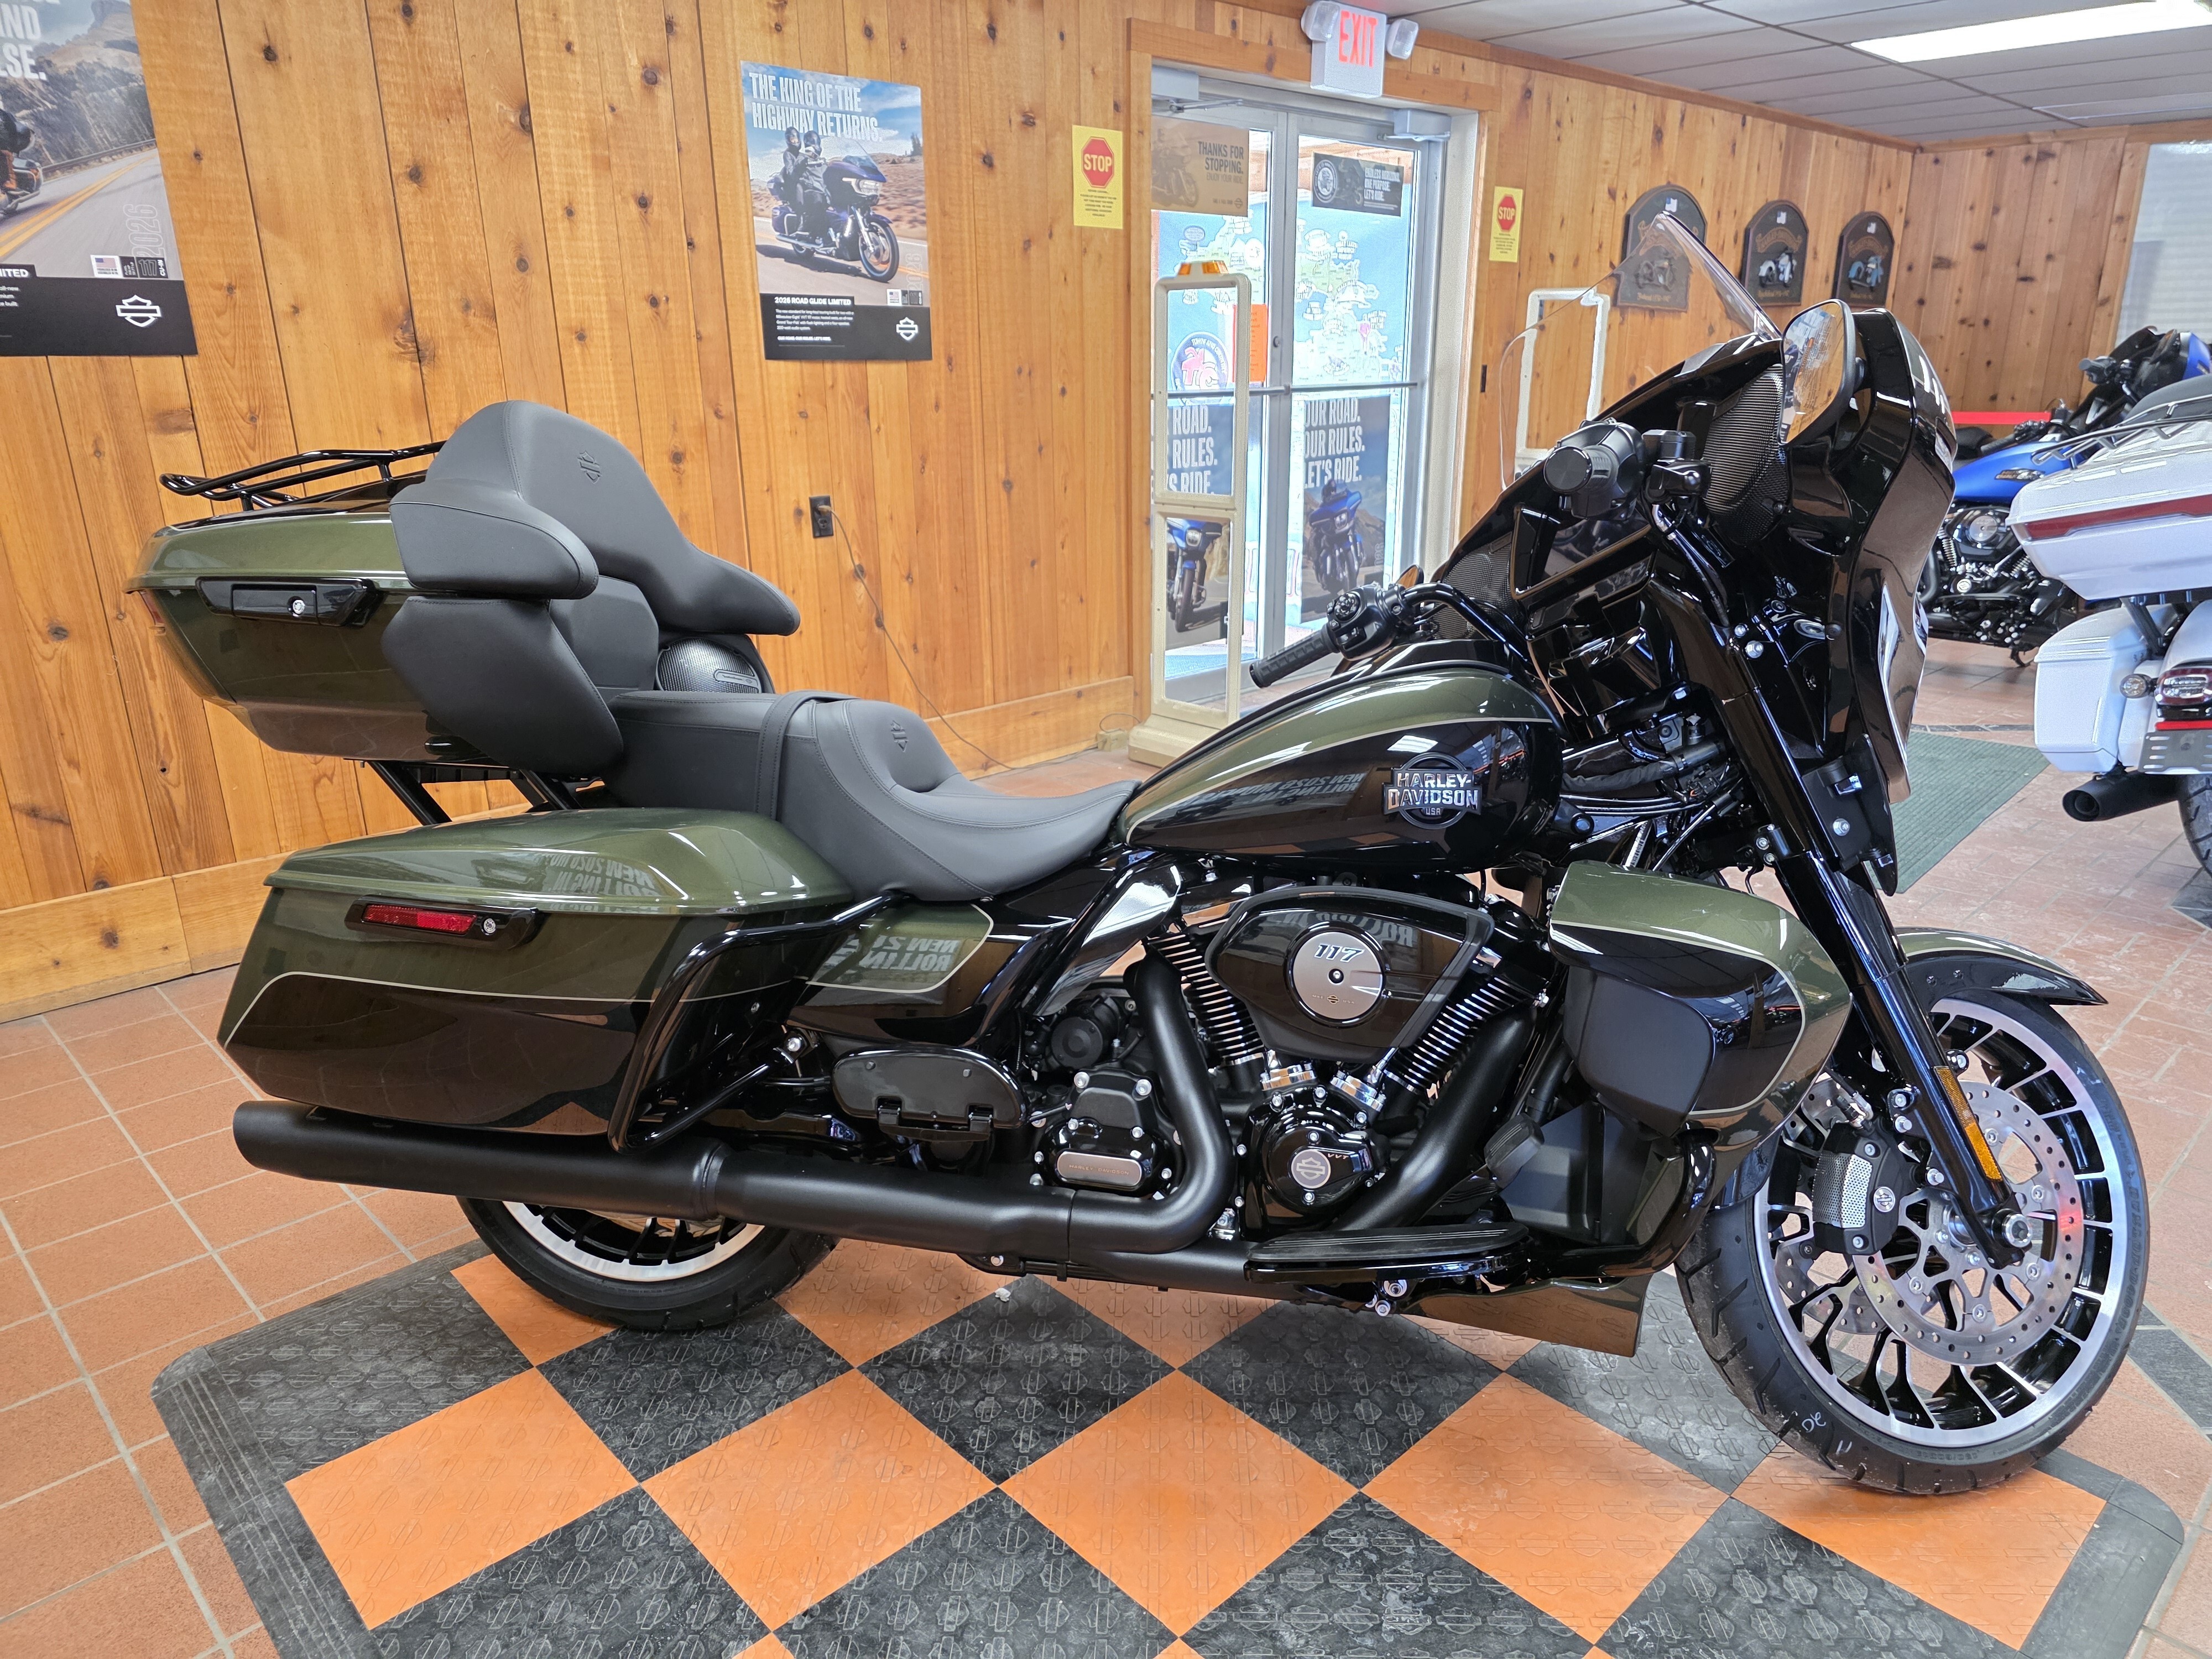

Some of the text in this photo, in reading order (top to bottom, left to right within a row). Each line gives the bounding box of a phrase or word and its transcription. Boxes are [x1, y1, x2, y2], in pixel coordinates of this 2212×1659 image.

[1339, 10, 1378, 69] EXIT
[749, 72, 862, 112] THE KING OF THE
[752, 102, 883, 142] HIGHWAY RETURNS.
[1198, 141, 1244, 160] THANKS FOR
[1083, 154, 1112, 172] STOP
[1204, 157, 1244, 174] STOPPING.
[1220, 174, 1232, 182] YOUR
[1498, 206, 1515, 220] STOP
[123, 204, 166, 257] 2026
[1172, 404, 1212, 435] ROAD.
[1329, 397, 1361, 425] ROAD.
[1328, 425, 1365, 455] RULES.
[1172, 437, 1218, 469] RULES.
[1304, 455, 1362, 489] ET'S RIDE.
[1397, 773, 1472, 788] HARLEY-
[1387, 789, 1479, 810] DAVIDSON
[1426, 807, 1442, 816] USA
[1314, 943, 1365, 963] 117
